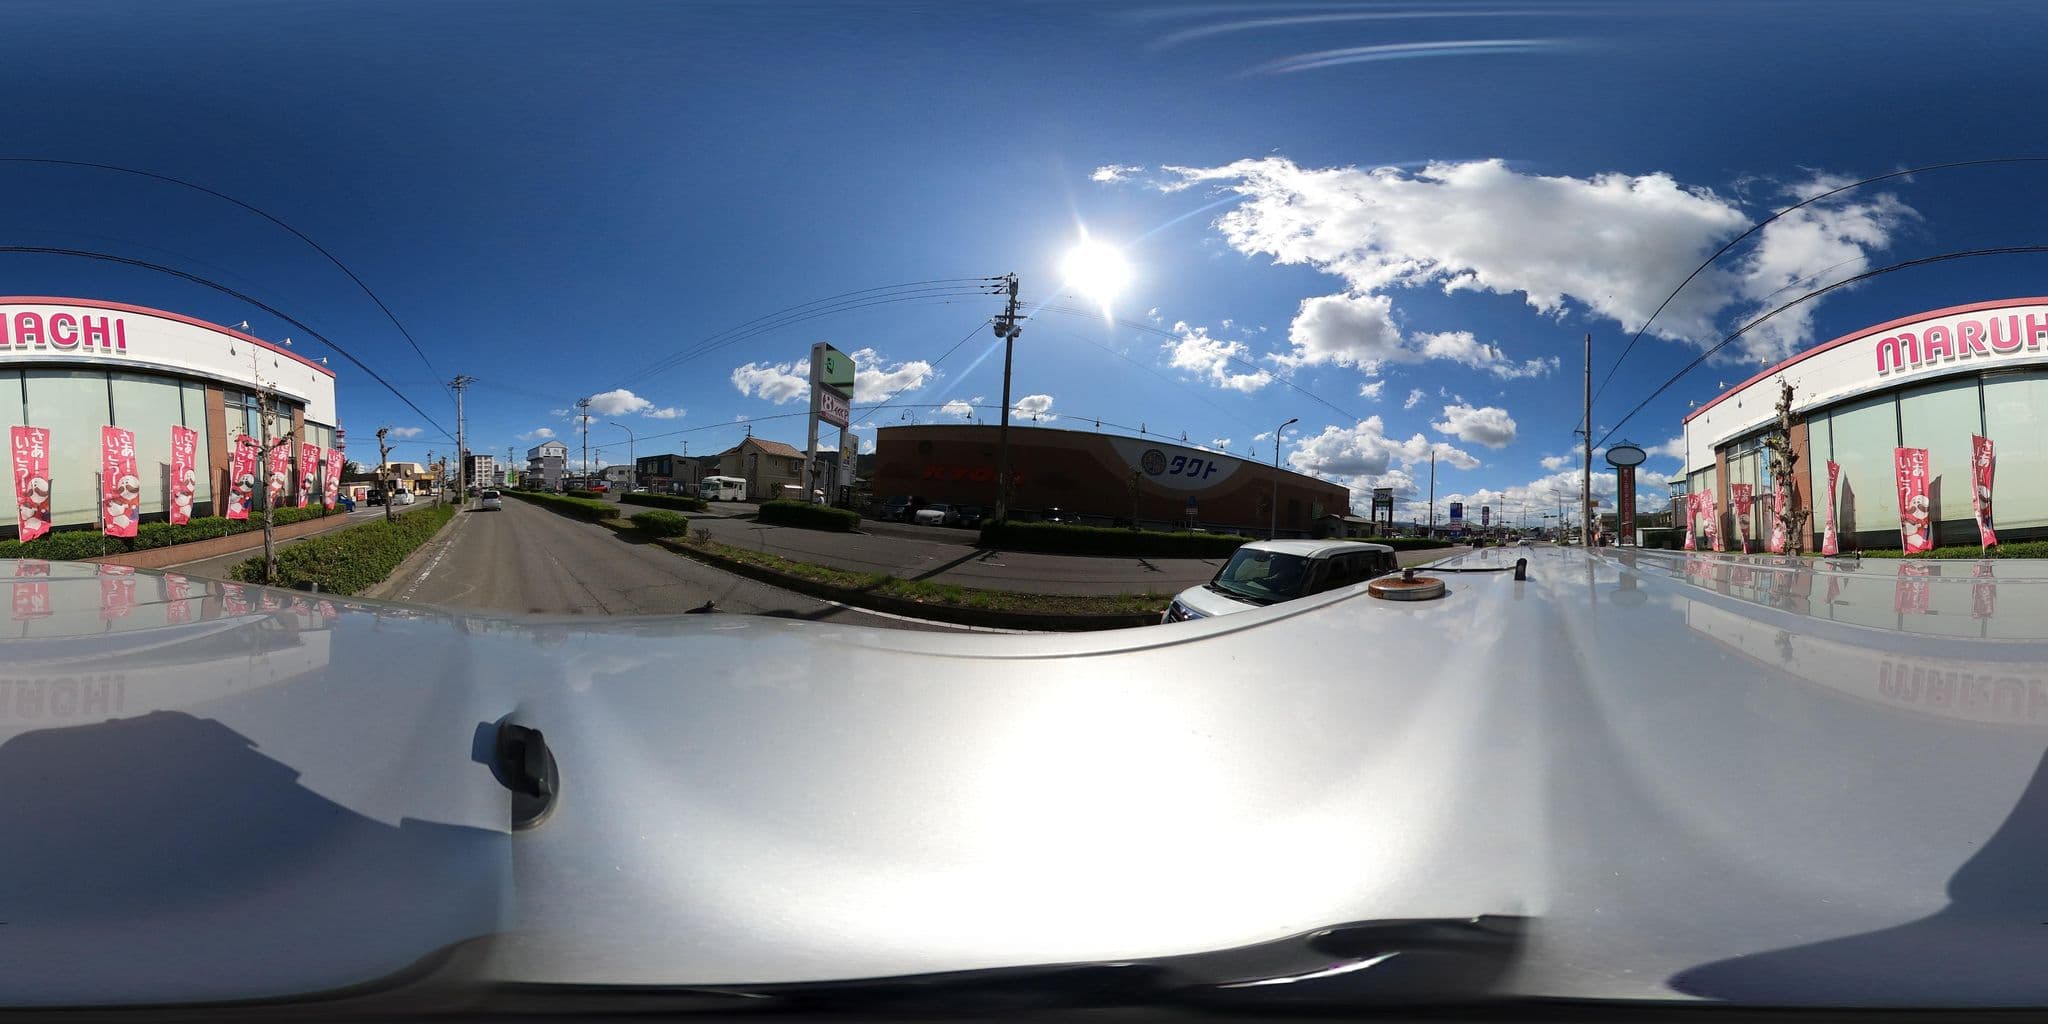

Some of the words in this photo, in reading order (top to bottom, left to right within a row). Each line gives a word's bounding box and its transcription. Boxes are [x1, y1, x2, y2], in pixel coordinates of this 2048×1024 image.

[1875, 312, 2048, 374] MARUH
[1169, 455, 1218, 480] タクト
